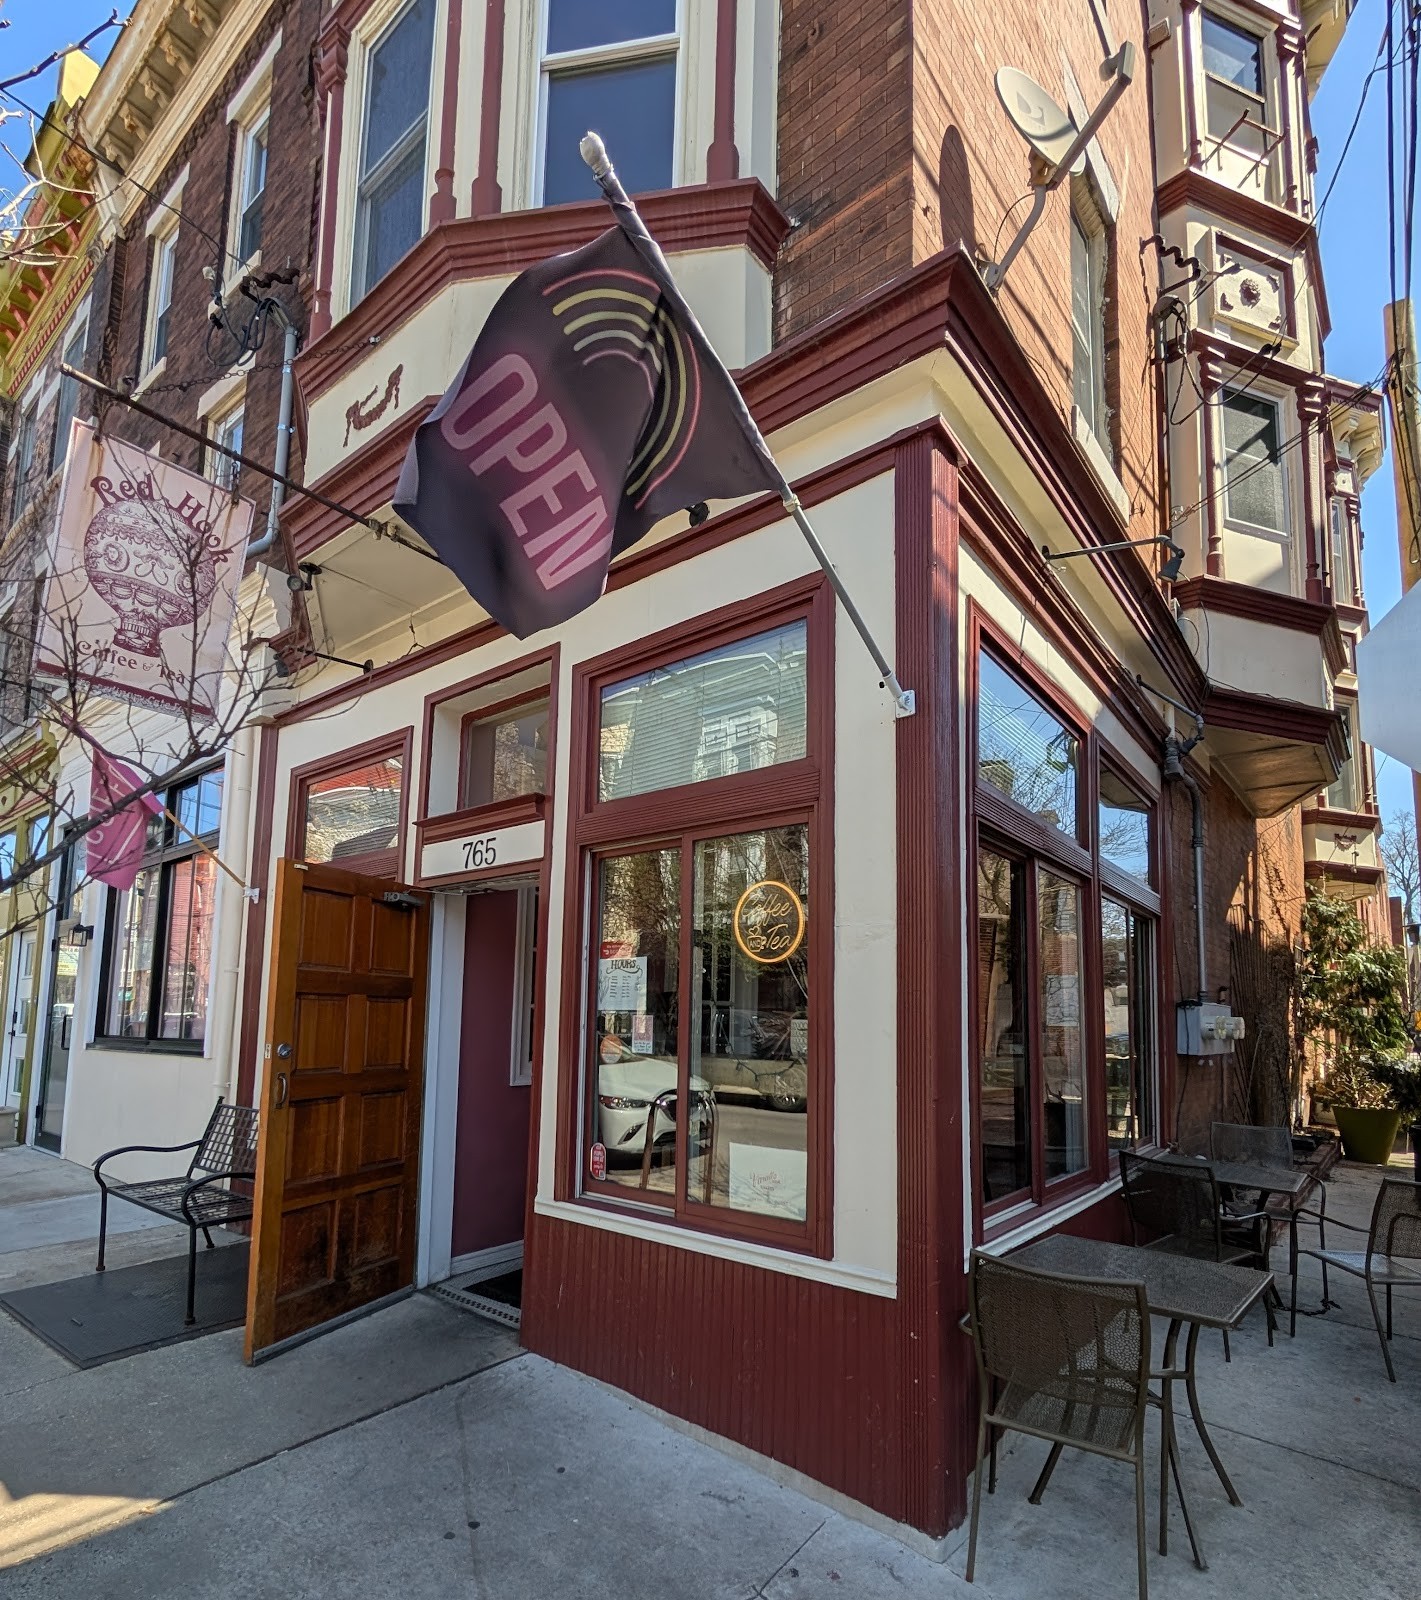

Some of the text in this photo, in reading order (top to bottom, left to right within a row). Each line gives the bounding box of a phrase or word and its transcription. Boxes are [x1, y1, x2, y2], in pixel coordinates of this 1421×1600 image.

[441, 353, 614, 590] OPEN
[90, 474, 153, 507] Red
[76, 640, 137, 670] Coffee
[157, 662, 186, 685] Tea
[462, 837, 497, 869] 765
[741, 894, 793, 926] Coffee
[766, 923, 793, 950] Tea
[611, 958, 637, 970] HOURS
